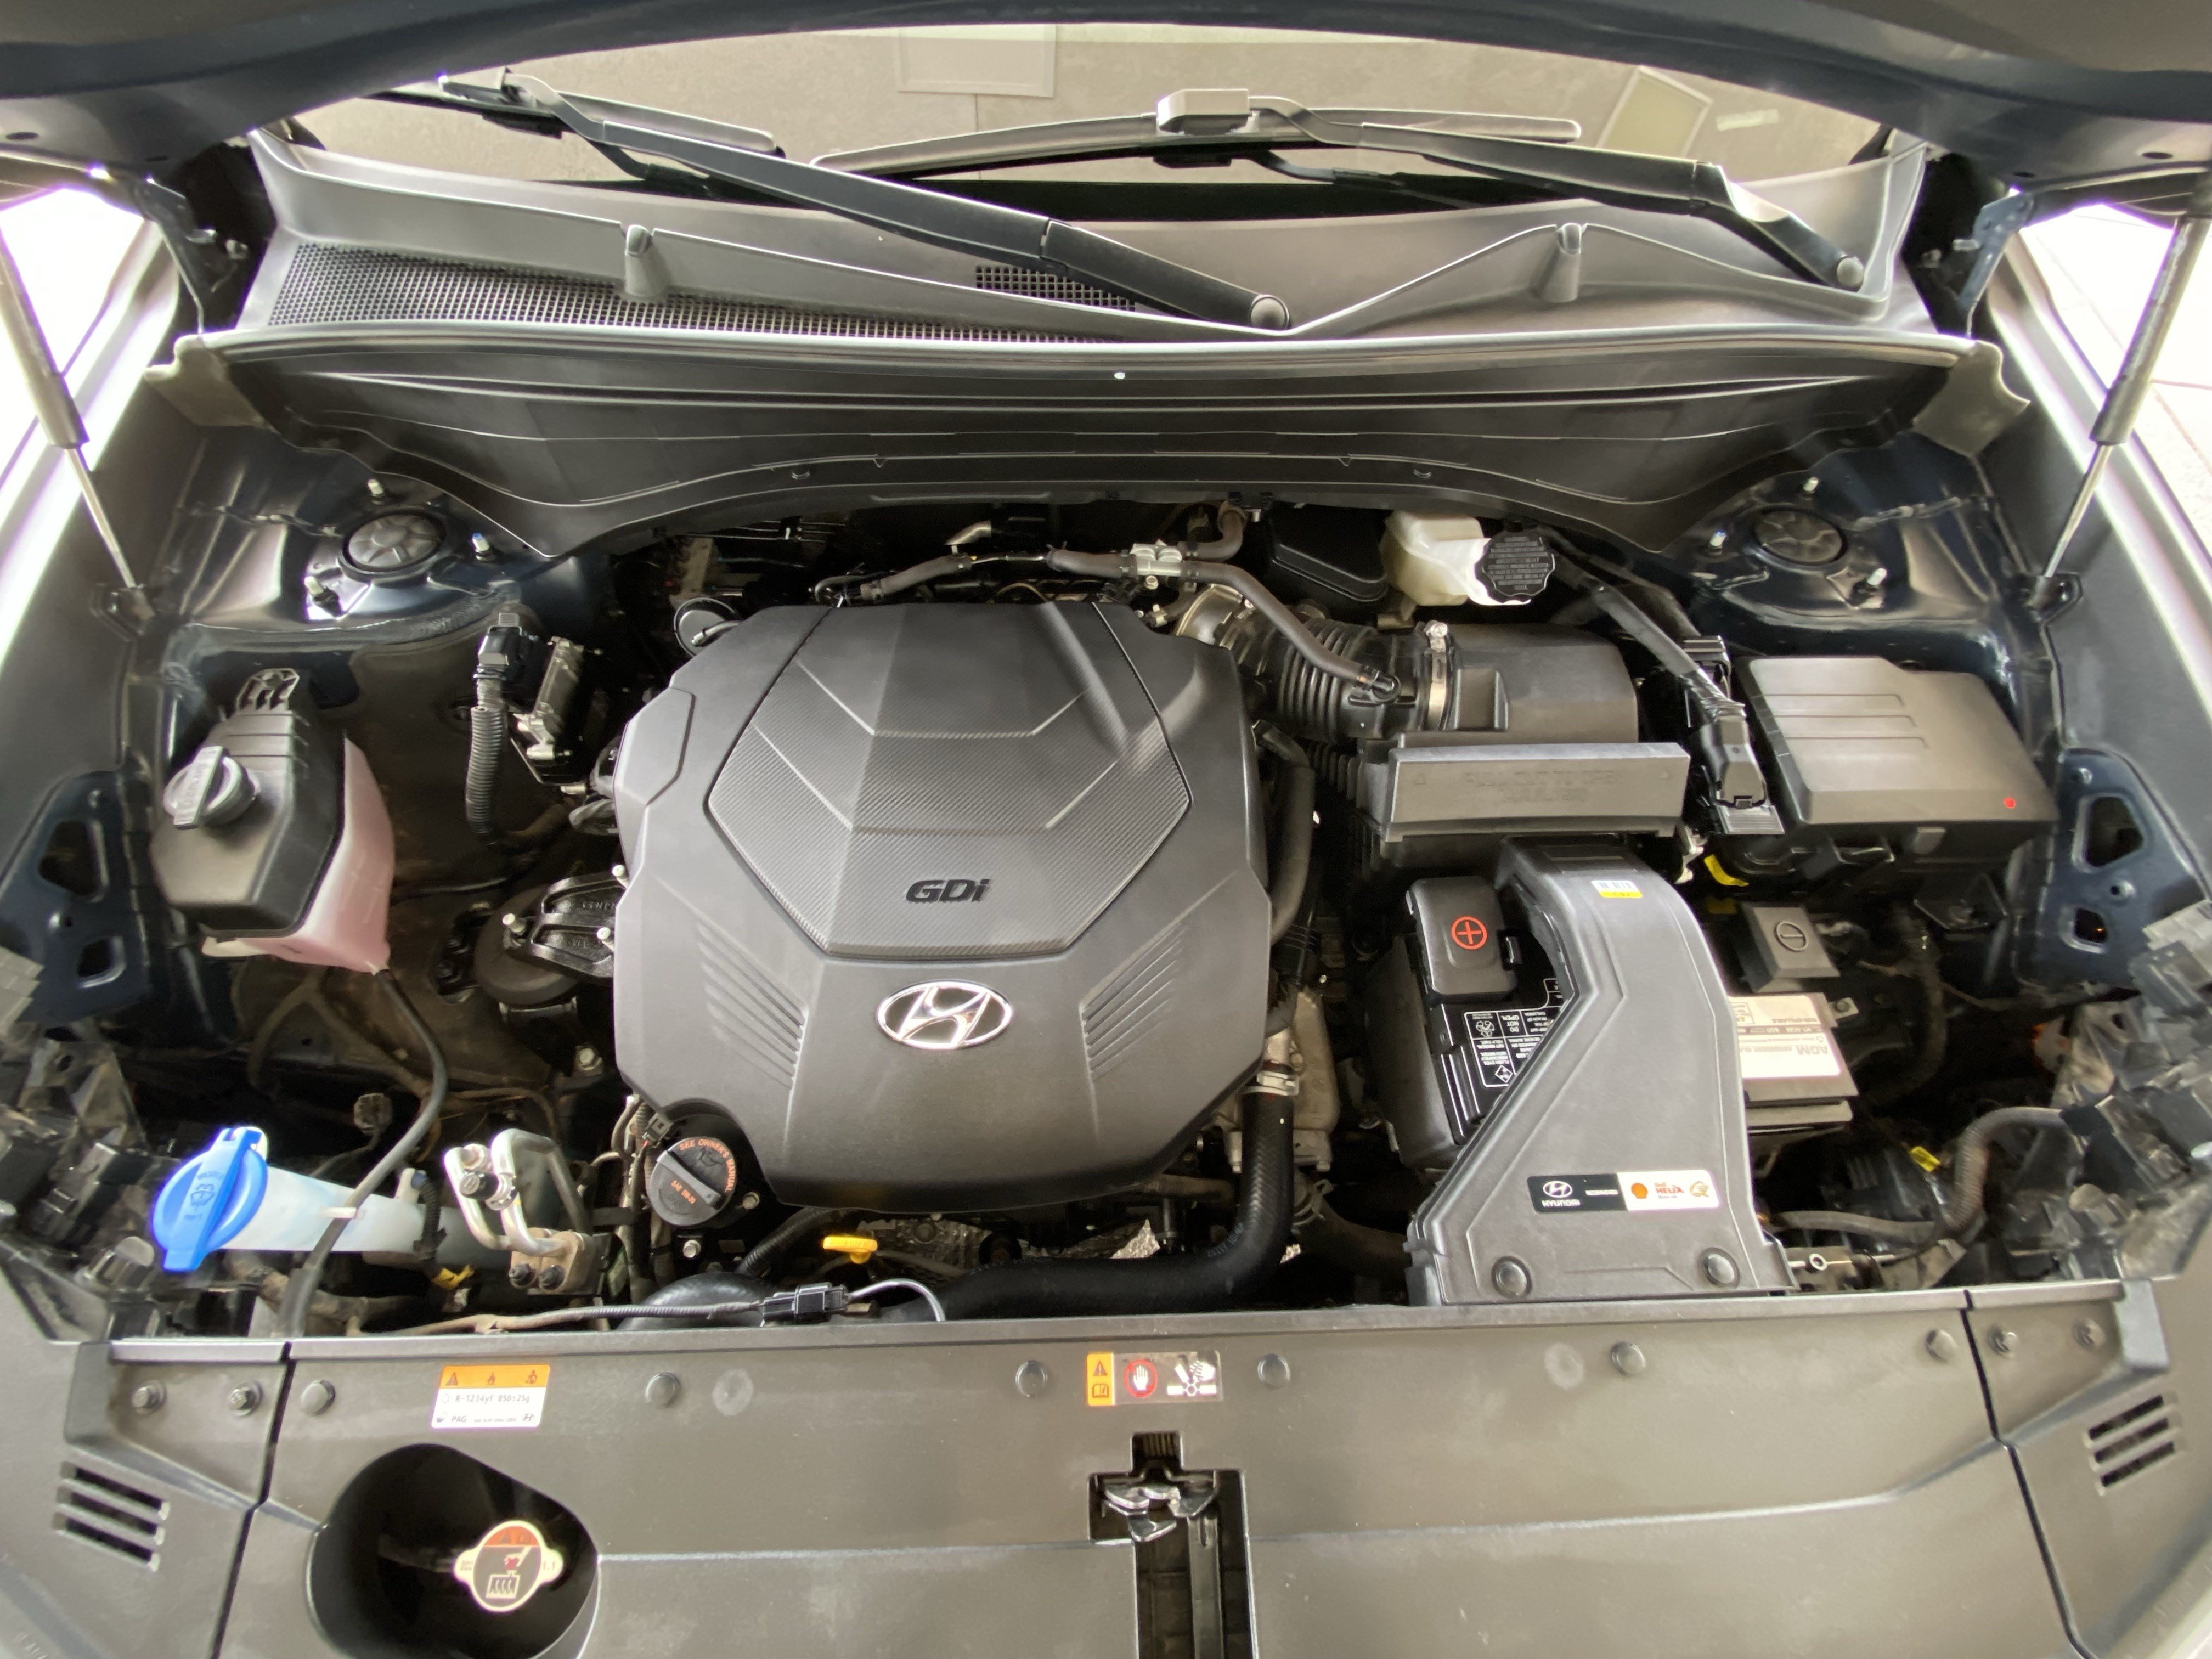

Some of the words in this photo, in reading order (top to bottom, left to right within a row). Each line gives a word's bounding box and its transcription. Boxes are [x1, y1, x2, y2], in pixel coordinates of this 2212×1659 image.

[906, 879, 990, 902] GDi
[1798, 1045, 1828, 1055] AGM
[679, 1139, 696, 1150] SEE
[697, 1138, 729, 1158] OWNER'S
[724, 1158, 736, 1193] MANUAL
[1656, 1185, 1685, 1194] HELIX
[1542, 1199, 1581, 1207] HYUNDAI
[455, 1393, 494, 1404] R-1234yf
